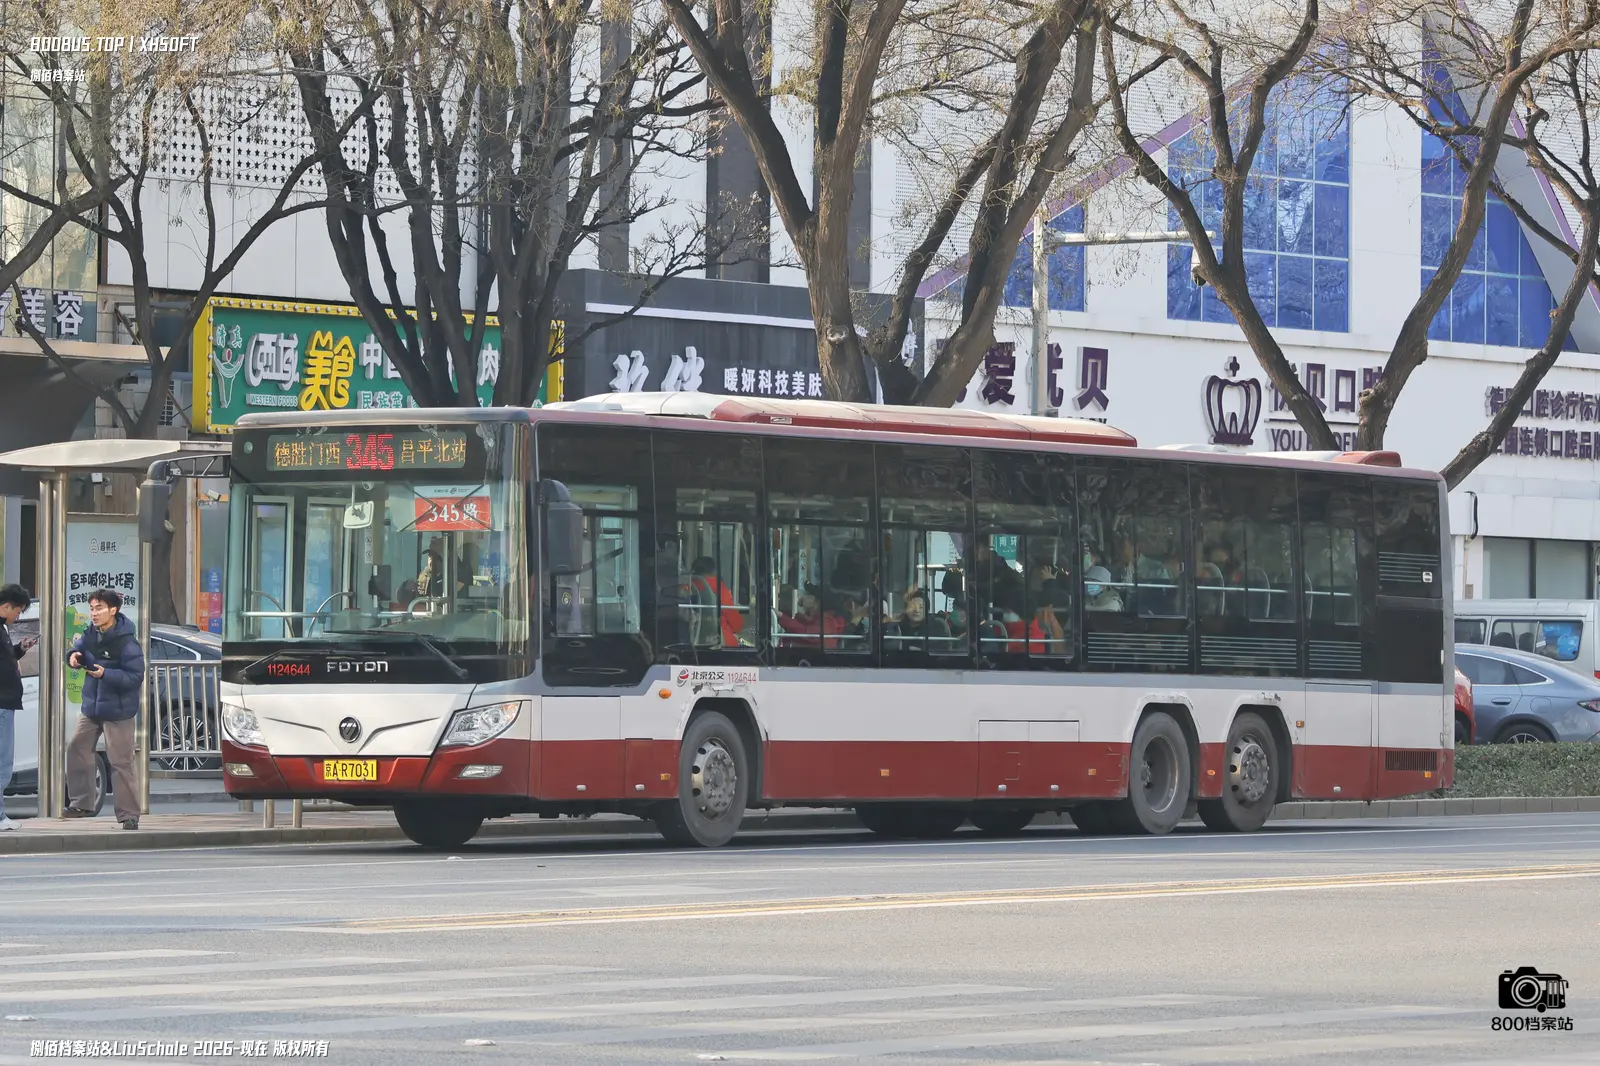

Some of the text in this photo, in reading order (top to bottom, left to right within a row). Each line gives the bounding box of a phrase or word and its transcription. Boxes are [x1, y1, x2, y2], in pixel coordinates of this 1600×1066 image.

[723, 367, 823, 397] 暖妍科技美肤
[248, 394, 299, 408] WESTERN FOODS
[1484, 386, 1600, 422] 德口腔诊疗标
[1267, 428, 1303, 452] YOU
[1492, 426, 1600, 461] 国连锁口腔品
[275, 433, 467, 470] 德胜门西 345 昌平北站
[428, 502, 478, 523] 345路
[70, 571, 135, 590] 昌平喊你上托育
[267, 663, 311, 676] 1124644
[691, 671, 725, 680] 北京公交
[727, 672, 757, 684] 1124644
